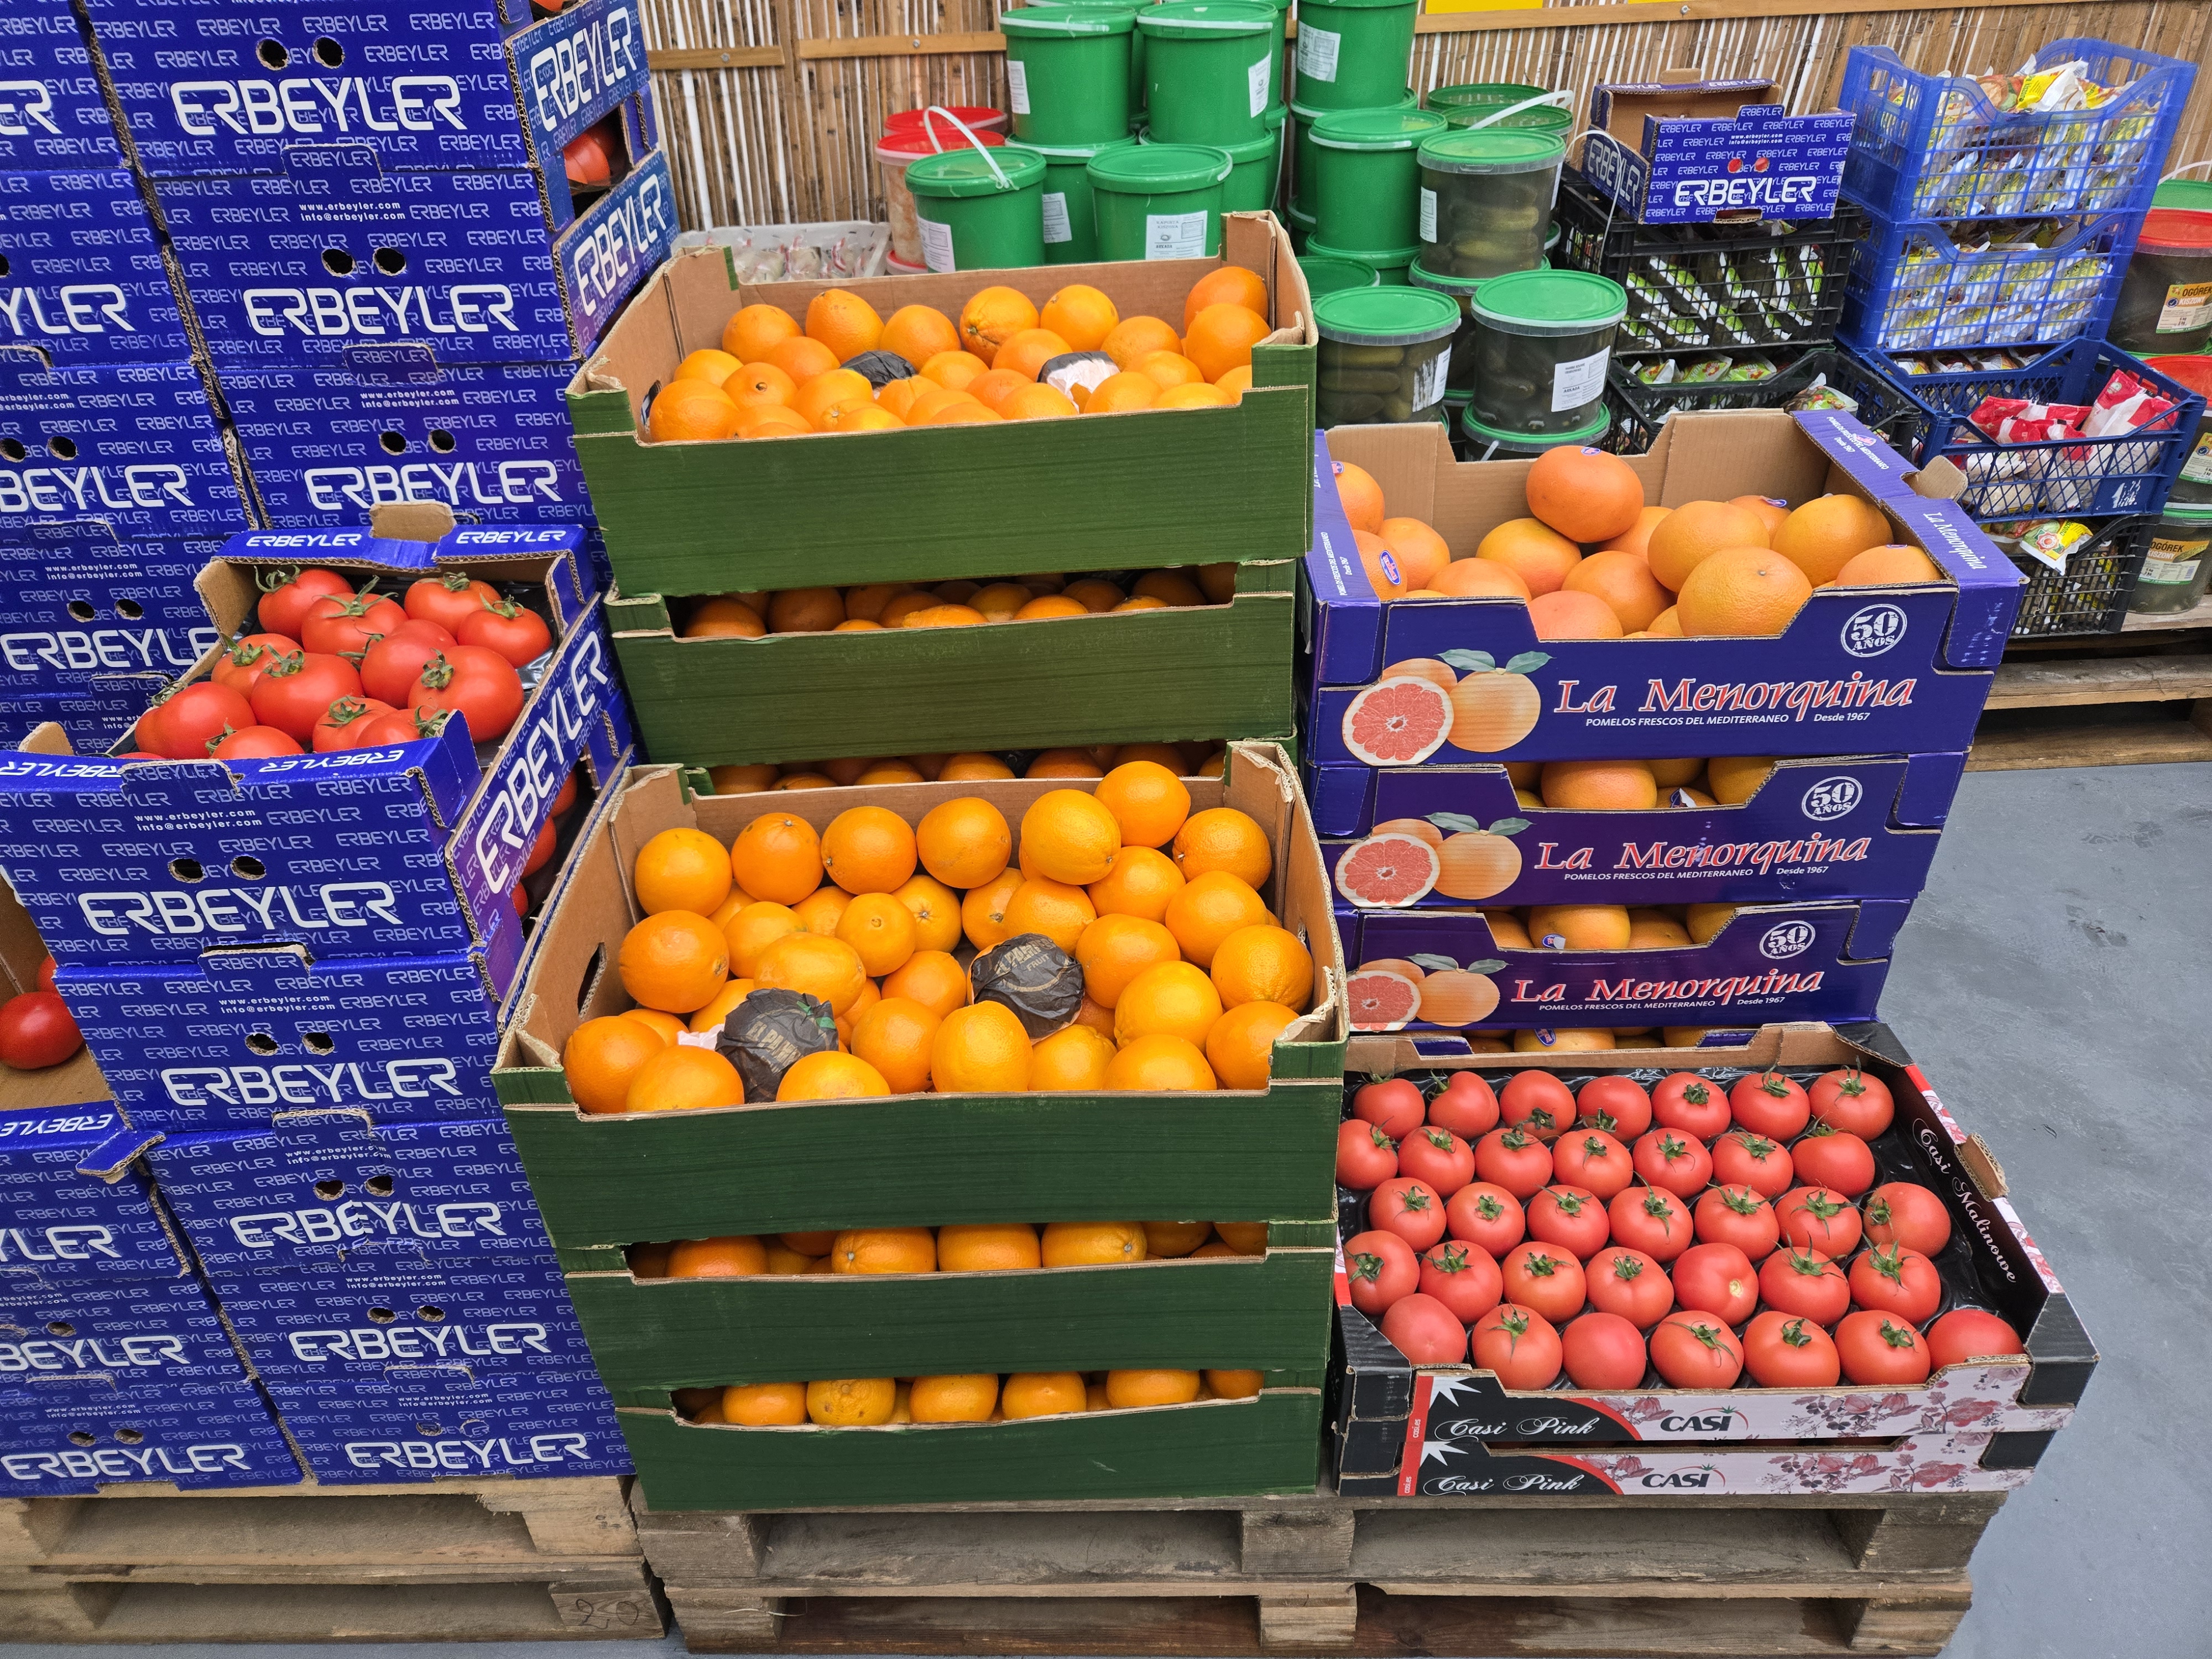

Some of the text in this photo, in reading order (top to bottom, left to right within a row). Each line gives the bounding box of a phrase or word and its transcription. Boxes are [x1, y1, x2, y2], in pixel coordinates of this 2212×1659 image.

[196, 18, 283, 36] ERBEYLER
[302, 15, 389, 33] ERBEYLER
[409, 12, 495, 30] ERBEYLER
[155, 50, 239, 68] ERBEYLER
[364, 45, 449, 62] ERBEYLER
[530, 7, 637, 132] ERBEYLER
[170, 76, 467, 134] ERBEYLER
[1741, 107, 1782, 116] ERBEYLER
[1660, 124, 1701, 133] ERBEYLER
[1712, 123, 1753, 132] ERBEYLER
[1763, 121, 1804, 129] ERBEYLER
[34, 137, 118, 155] ERBEYLER
[439, 134, 521, 150] ERBEYLER
[1683, 138, 1724, 147] ERBEYLER
[1785, 134, 1826, 143] ERBEYLER
[290, 148, 375, 166] ERBEYLER
[1588, 138, 1640, 208] ERBEYLER
[49, 173, 134, 190] ERBEYLER
[452, 174, 534, 190] ERBEYLER
[1675, 176, 1817, 207] ERBEYLER
[299, 202, 400, 211] www.erbeyler.com
[409, 204, 489, 220] ERBEYLER
[211, 207, 290, 223] ERBEYLER
[301, 212, 405, 222] info@erbeyler.com
[467, 229, 546, 245] ERBEYLER
[574, 173, 667, 317] ERBEYLER
[229, 262, 307, 276] ERBEYLER
[425, 258, 503, 273] ERBEYLER
[0, 284, 137, 335] YLER
[243, 284, 519, 336] ERBEYLER
[493, 334, 569, 349] ERBEYLER
[77, 393, 156, 408] ERBEYLER
[361, 390, 455, 399] www.erbeyler.com
[463, 389, 537, 404] ERBEYLER
[274, 397, 352, 411] ERBEYLER
[362, 399, 459, 408] info@erbeyler.com
[40, 419, 118, 433] ERBEYLER
[135, 415, 213, 430] ERBEYLER
[97, 441, 174, 455] ERBEYLER
[476, 437, 548, 451] ERBEYLER
[0, 465, 195, 512] BEYLER
[304, 459, 562, 510] ERBEYLER
[246, 534, 362, 546] ERBEYLER
[456, 531, 566, 544] ERBEYLER
[1923, 512, 1939, 525] La
[1934, 522, 1987, 570] Menorquina
[2151, 541, 2185, 552] OGÓREK
[2147, 550, 2176, 560] KISZONY
[1851, 611, 1899, 641] 50
[1553, 671, 1918, 722] La Menorquina
[1585, 712, 1870, 727] POMELOS FRESCOS DEL MEDITERRANEO Desde 1967
[258, 748, 405, 774] ERBEYLER
[476, 630, 608, 895] ERBEYLER
[1811, 776, 1855, 806] 50
[134, 810, 257, 823] www.erbeyler.com
[267, 807, 362, 825] ERBEYLER
[33, 819, 126, 832] ERBEYLER
[136, 818, 262, 831] info@erbeyler.com
[336, 829, 431, 846] ERBEYLER
[102, 842, 196, 856] ERBEYLER
[1534, 832, 1872, 875] La Menorquina
[288, 857, 381, 874] ERBEYLER
[1613, 872, 1656, 880] FRESCOS
[1657, 872, 1676, 880] DEL
[1676, 868, 1754, 879] MEDITERRANEO
[1806, 866, 1829, 874] 1967
[77, 881, 404, 935] ERBEYLER
[1768, 926, 1808, 948] 50
[208, 956, 299, 970] ERBEYLER
[275, 971, 364, 989] ERBEYLER
[387, 966, 476, 984] ERBEYLER
[1511, 968, 1825, 1005] La Menorquina
[219, 996, 331, 1007] www.erbeyler.com
[220, 1003, 335, 1013] info@erbeyler.com
[340, 993, 428, 1009] ERBEYLER
[1644, 1000, 1716, 1010] MEDITERRANEO
[121, 1004, 209, 1016] ERBEYLER
[160, 1058, 463, 1105] ERBEYLER
[1913, 1118, 2016, 1283] Casi Malinowe
[229, 1202, 507, 1248] ERBEYLER
[346, 1275, 443, 1284] www.erbeyler.com
[288, 1323, 552, 1361] ERBEYLER
[0, 1335, 191, 1371] BEYLER
[1412, 1418, 1422, 1439] casi.es
[1434, 1416, 1601, 1441] Casi Pink
[1660, 1416, 1731, 1432] CASI
[345, 1433, 591, 1469] ERBEYLER
[1, 1443, 252, 1480] ERBEYLER
[1404, 1475, 1412, 1494] casi.es
[1423, 1472, 1585, 1496] Casi Pink
[1642, 1474, 1711, 1488] CASI
